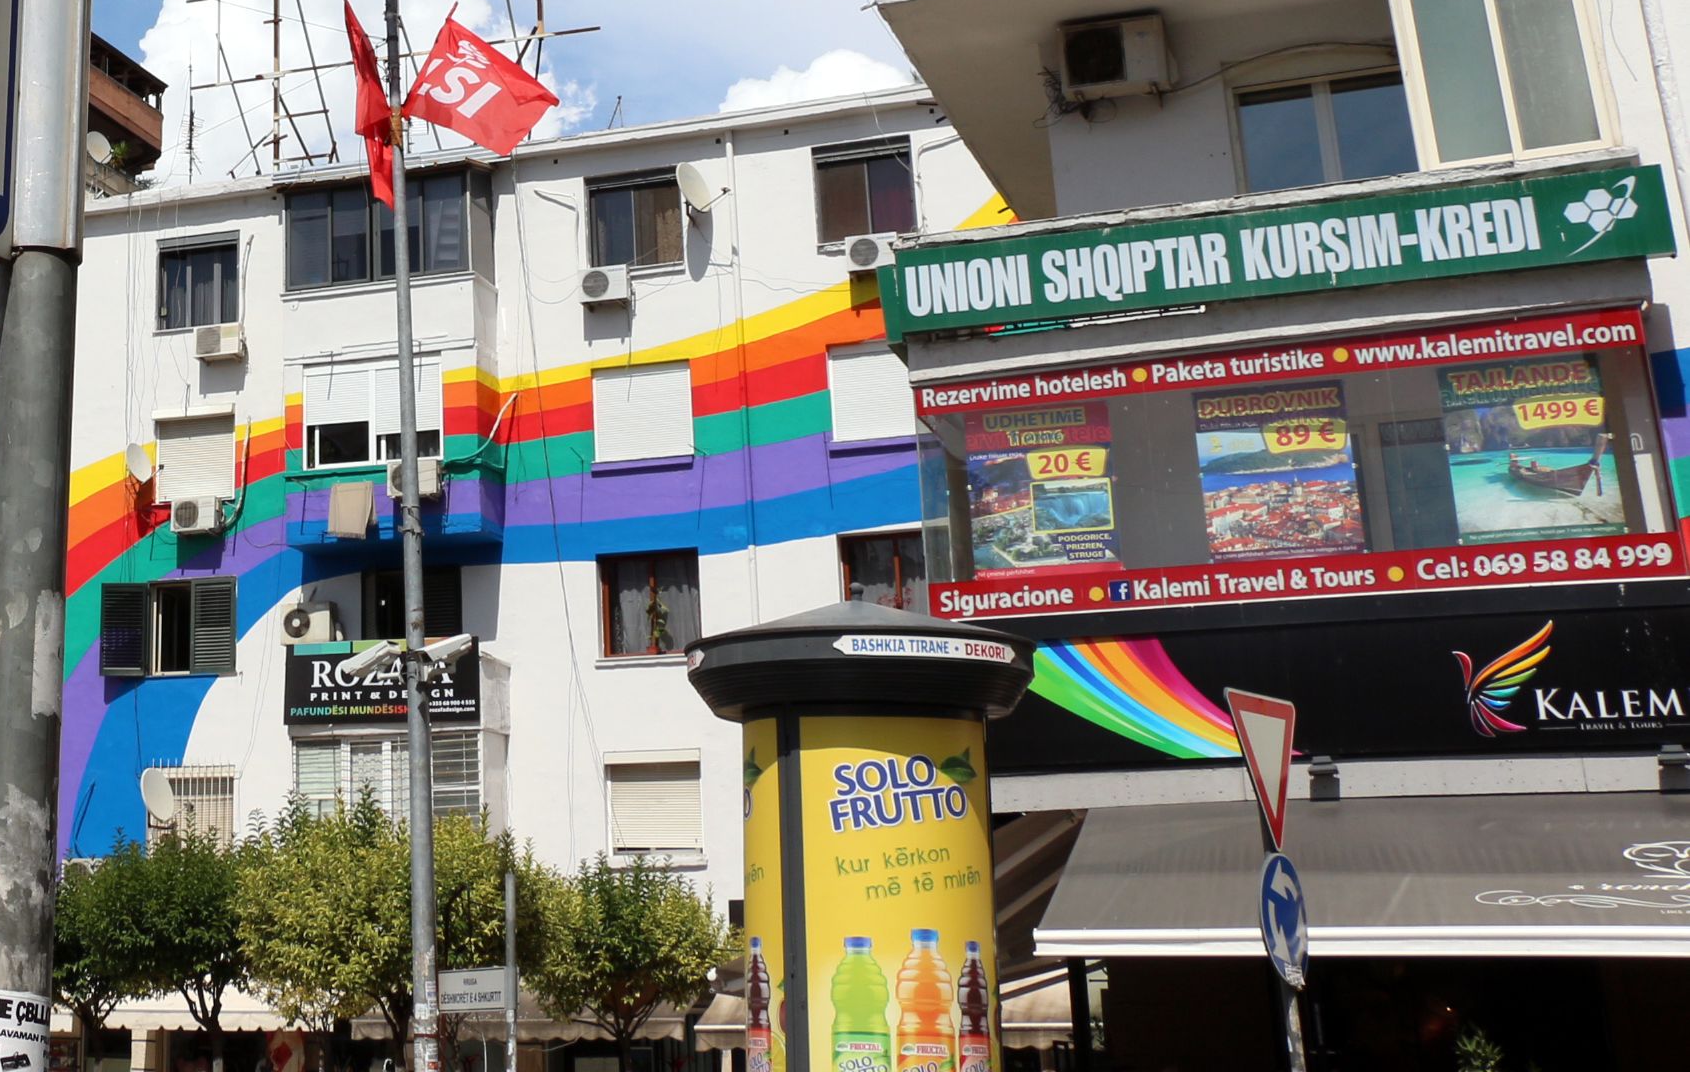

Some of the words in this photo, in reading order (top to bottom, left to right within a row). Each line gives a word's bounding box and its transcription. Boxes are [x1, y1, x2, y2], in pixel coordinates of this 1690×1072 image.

[905, 254, 1032, 317] UNIONI
[1042, 232, 1231, 303] SHQIPTAR
[1240, 196, 1541, 281] KURSIM-KREDI
[923, 380, 1030, 407] Rezervime
[1035, 368, 1126, 396] hotelesh
[1152, 355, 1226, 383] Paketa
[1230, 348, 1323, 375] turistike
[1354, 323, 1636, 364] www.kalemitravel.com
[1451, 362, 1589, 391] TAJLANDE
[1200, 390, 1338, 417] DUBROVNIK
[1518, 401, 1577, 422] 1499
[986, 409, 1084, 428] UDHETIME
[1276, 424, 1310, 446] 89
[1318, 422, 1336, 443] €
[1038, 453, 1069, 474] 20
[1076, 452, 1091, 472] €
[1069, 551, 1104, 559] STRUGE
[940, 584, 1073, 615] Siguracione
[1134, 574, 1210, 600] Kalemi
[1215, 568, 1285, 594] Travel
[1290, 567, 1307, 588] &
[1311, 564, 1375, 587] Tours
[1416, 556, 1469, 580] Cel:
[1474, 553, 1526, 575] 069
[1533, 551, 1569, 572] 58
[1574, 547, 1611, 569] 84
[1617, 543, 1673, 567] 999
[852, 639, 905, 653] BASHKIA
[910, 640, 949, 654] TIRANE
[965, 643, 1006, 660] DEKORI
[311, 657, 453, 688] ROZAA
[310, 691, 362, 701] PRINT
[389, 689, 453, 699] DEGN
[1534, 688, 1690, 720] KALEM
[290, 705, 348, 716] PAFUNDËSI
[834, 755, 936, 797] SOLO
[829, 784, 968, 832] FRUTTO
[835, 856, 870, 876] kur
[883, 847, 950, 869] kërkon
[866, 877, 901, 900] më
[914, 872, 934, 894] të
[944, 866, 981, 890] mirën
[916, 1045, 947, 1054] FRUCTAL
